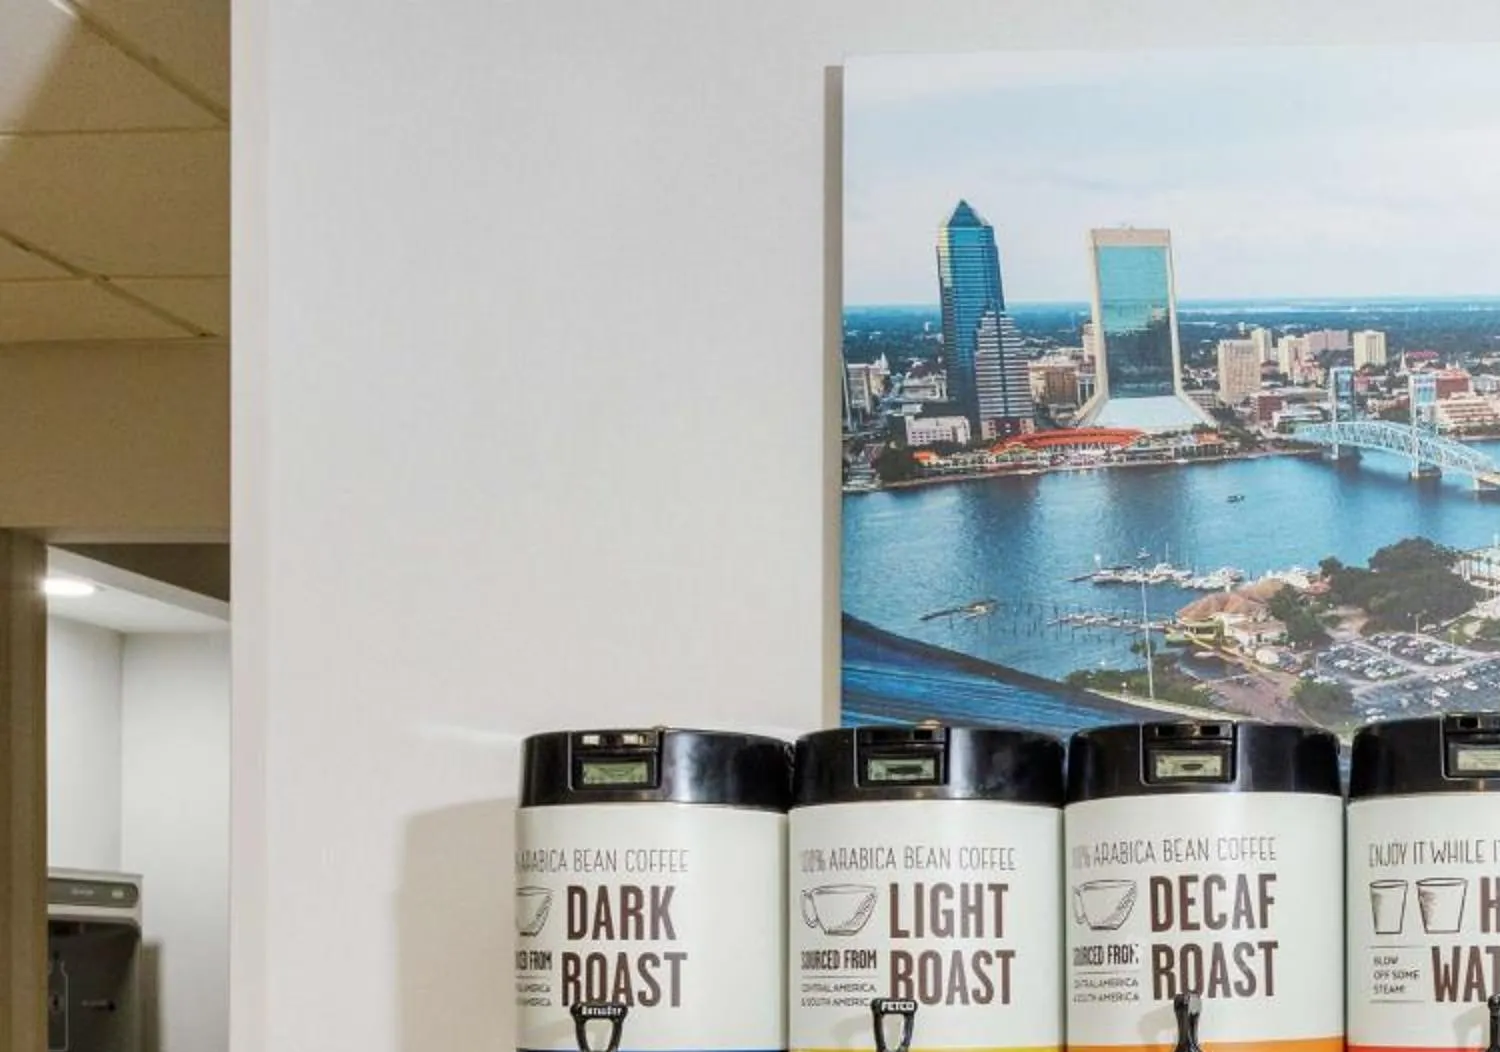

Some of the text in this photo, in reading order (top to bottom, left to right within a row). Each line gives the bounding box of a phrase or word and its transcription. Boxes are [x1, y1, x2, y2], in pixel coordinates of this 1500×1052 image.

[573, 849, 617, 873] BEAN
[625, 849, 688, 873] COFFEE
[829, 847, 896, 871] ARABICA
[904, 846, 951, 870] BEAN
[959, 847, 1016, 871] COFFEE
[1093, 841, 1157, 868] ARABICA
[1163, 838, 1210, 863] BEAN
[1217, 837, 1277, 861] COFFEE
[1368, 842, 1408, 868] ENJOY
[1412, 842, 1426, 866] IT
[1430, 840, 1485, 865] WHILE
[567, 884, 676, 941] DARK
[890, 882, 1008, 938] LIGHT
[1149, 873, 1277, 932] DECAF
[843, 949, 877, 969] FROM
[1107, 944, 1139, 965] FROM
[1152, 940, 1279, 1001] ROAST
[561, 951, 688, 1008] ROAST
[889, 949, 1016, 1006] ROAST
